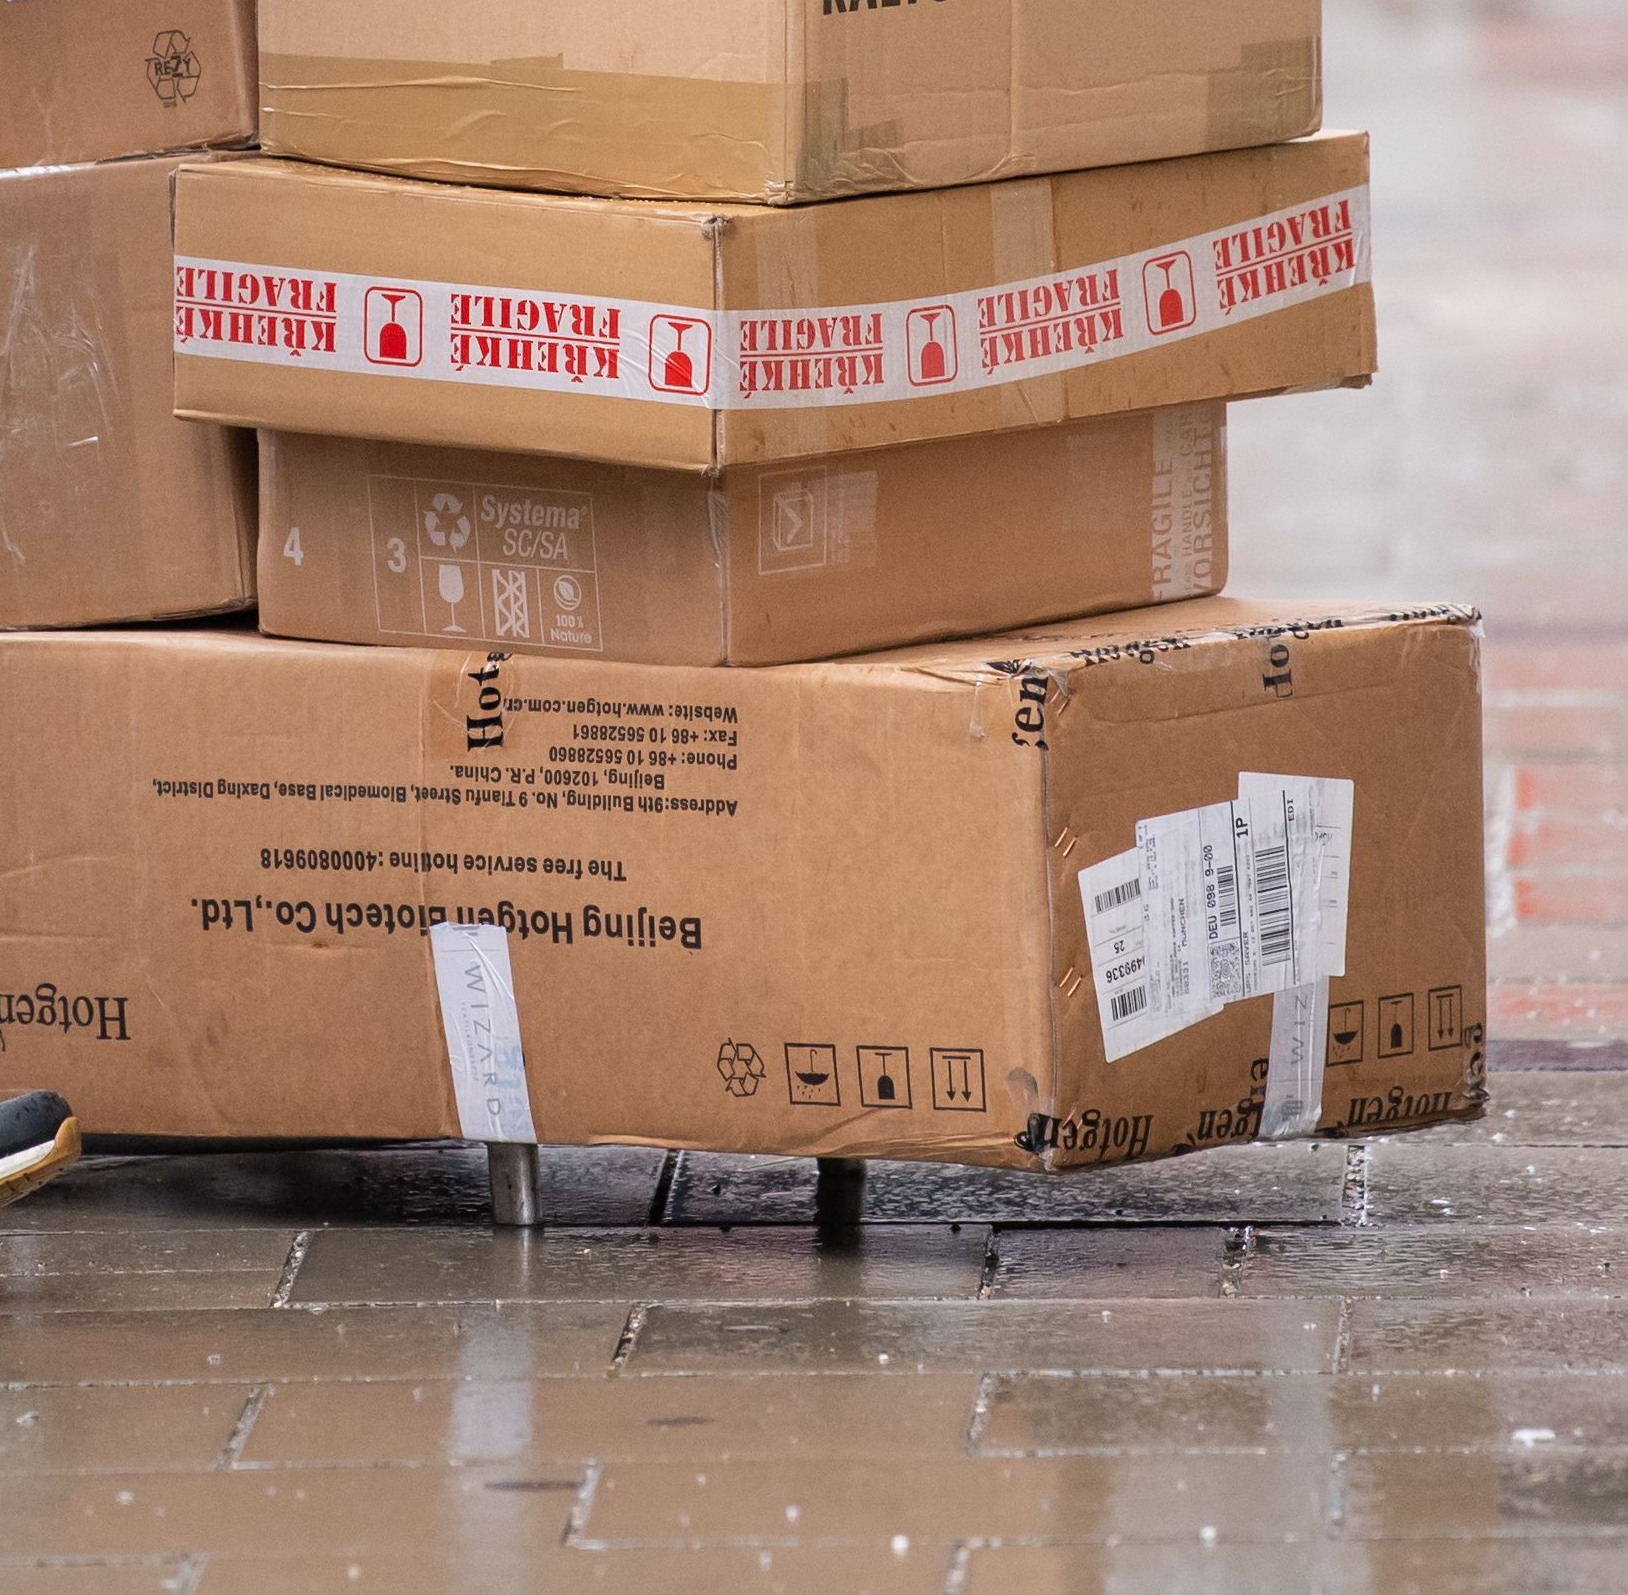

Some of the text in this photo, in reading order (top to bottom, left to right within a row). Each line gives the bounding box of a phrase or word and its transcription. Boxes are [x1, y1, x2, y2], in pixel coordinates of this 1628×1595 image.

[1213, 200, 1353, 271] FRAGILE
[1217, 238, 1356, 316] KŘEHKÉ
[176, 266, 337, 313] FRAGILE
[977, 268, 1120, 329] FRAGILE
[450, 293, 620, 339] FRAGILE
[176, 306, 337, 357] KŘEHKÉ
[739, 313, 883, 352] FRAGILE
[981, 307, 1124, 376] KŘEHKÉ
[450, 333, 620, 383] KŘEHKÉ
[739, 352, 884, 400] KŘEHKÉ
[283, 527, 304, 566] 4
[386, 537, 408, 574] 3
[503, 528, 569, 561] SC/SA
[550, 626, 592, 644] Nature
[668, 703, 737, 723] Website:
[572, 723, 737, 746] Fax: +86 10 56528861
[549, 745, 737, 770] Phone: +86 10 56528860
[152, 777, 214, 800] District,
[217, 778, 271, 801] Daxing
[449, 764, 666, 791] Beijing, 102600, P.R. China.
[273, 780, 317, 802] Base,
[320, 782, 407, 805] Biomedical
[409, 783, 462, 806] Street,
[464, 788, 517, 809] Tianfu
[518, 790, 529, 808] 9
[530, 791, 558, 810] No.
[560, 789, 635, 813] Building,
[1234, 817, 1250, 839] 1P
[389, 851, 459, 874] hotline
[462, 853, 538, 876] service
[541, 857, 584, 880] free
[586, 859, 627, 882] The
[583, 904, 703, 949] Beijing
[1207, 914, 1219, 941] DEU
